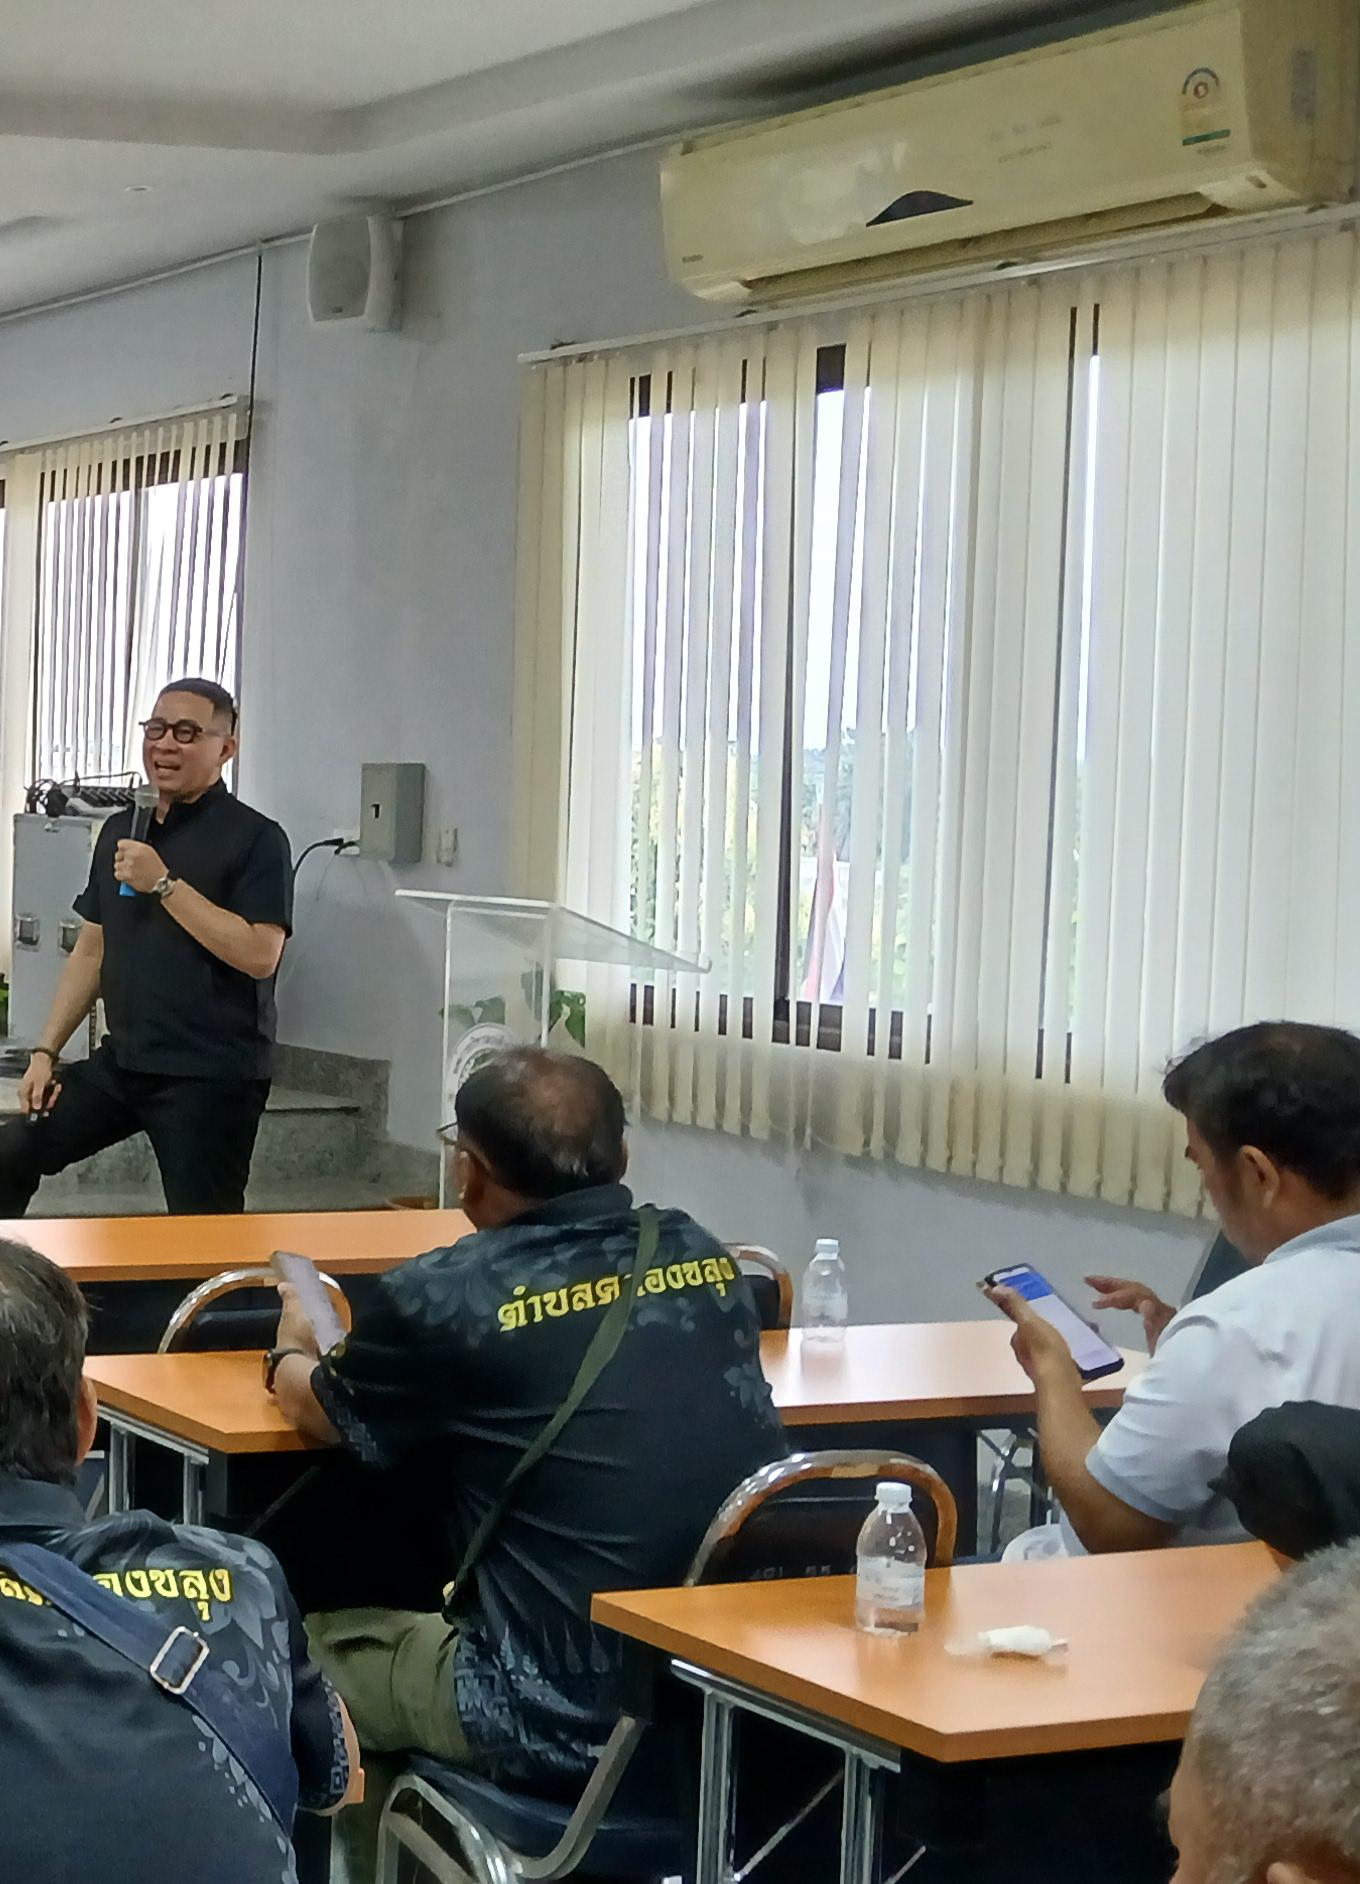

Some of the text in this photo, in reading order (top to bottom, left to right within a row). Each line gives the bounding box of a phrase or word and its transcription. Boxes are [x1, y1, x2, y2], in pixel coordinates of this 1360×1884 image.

[370, 803, 380, 819] 1
[496, 1256, 736, 1333] ตำบลคองขลุง
